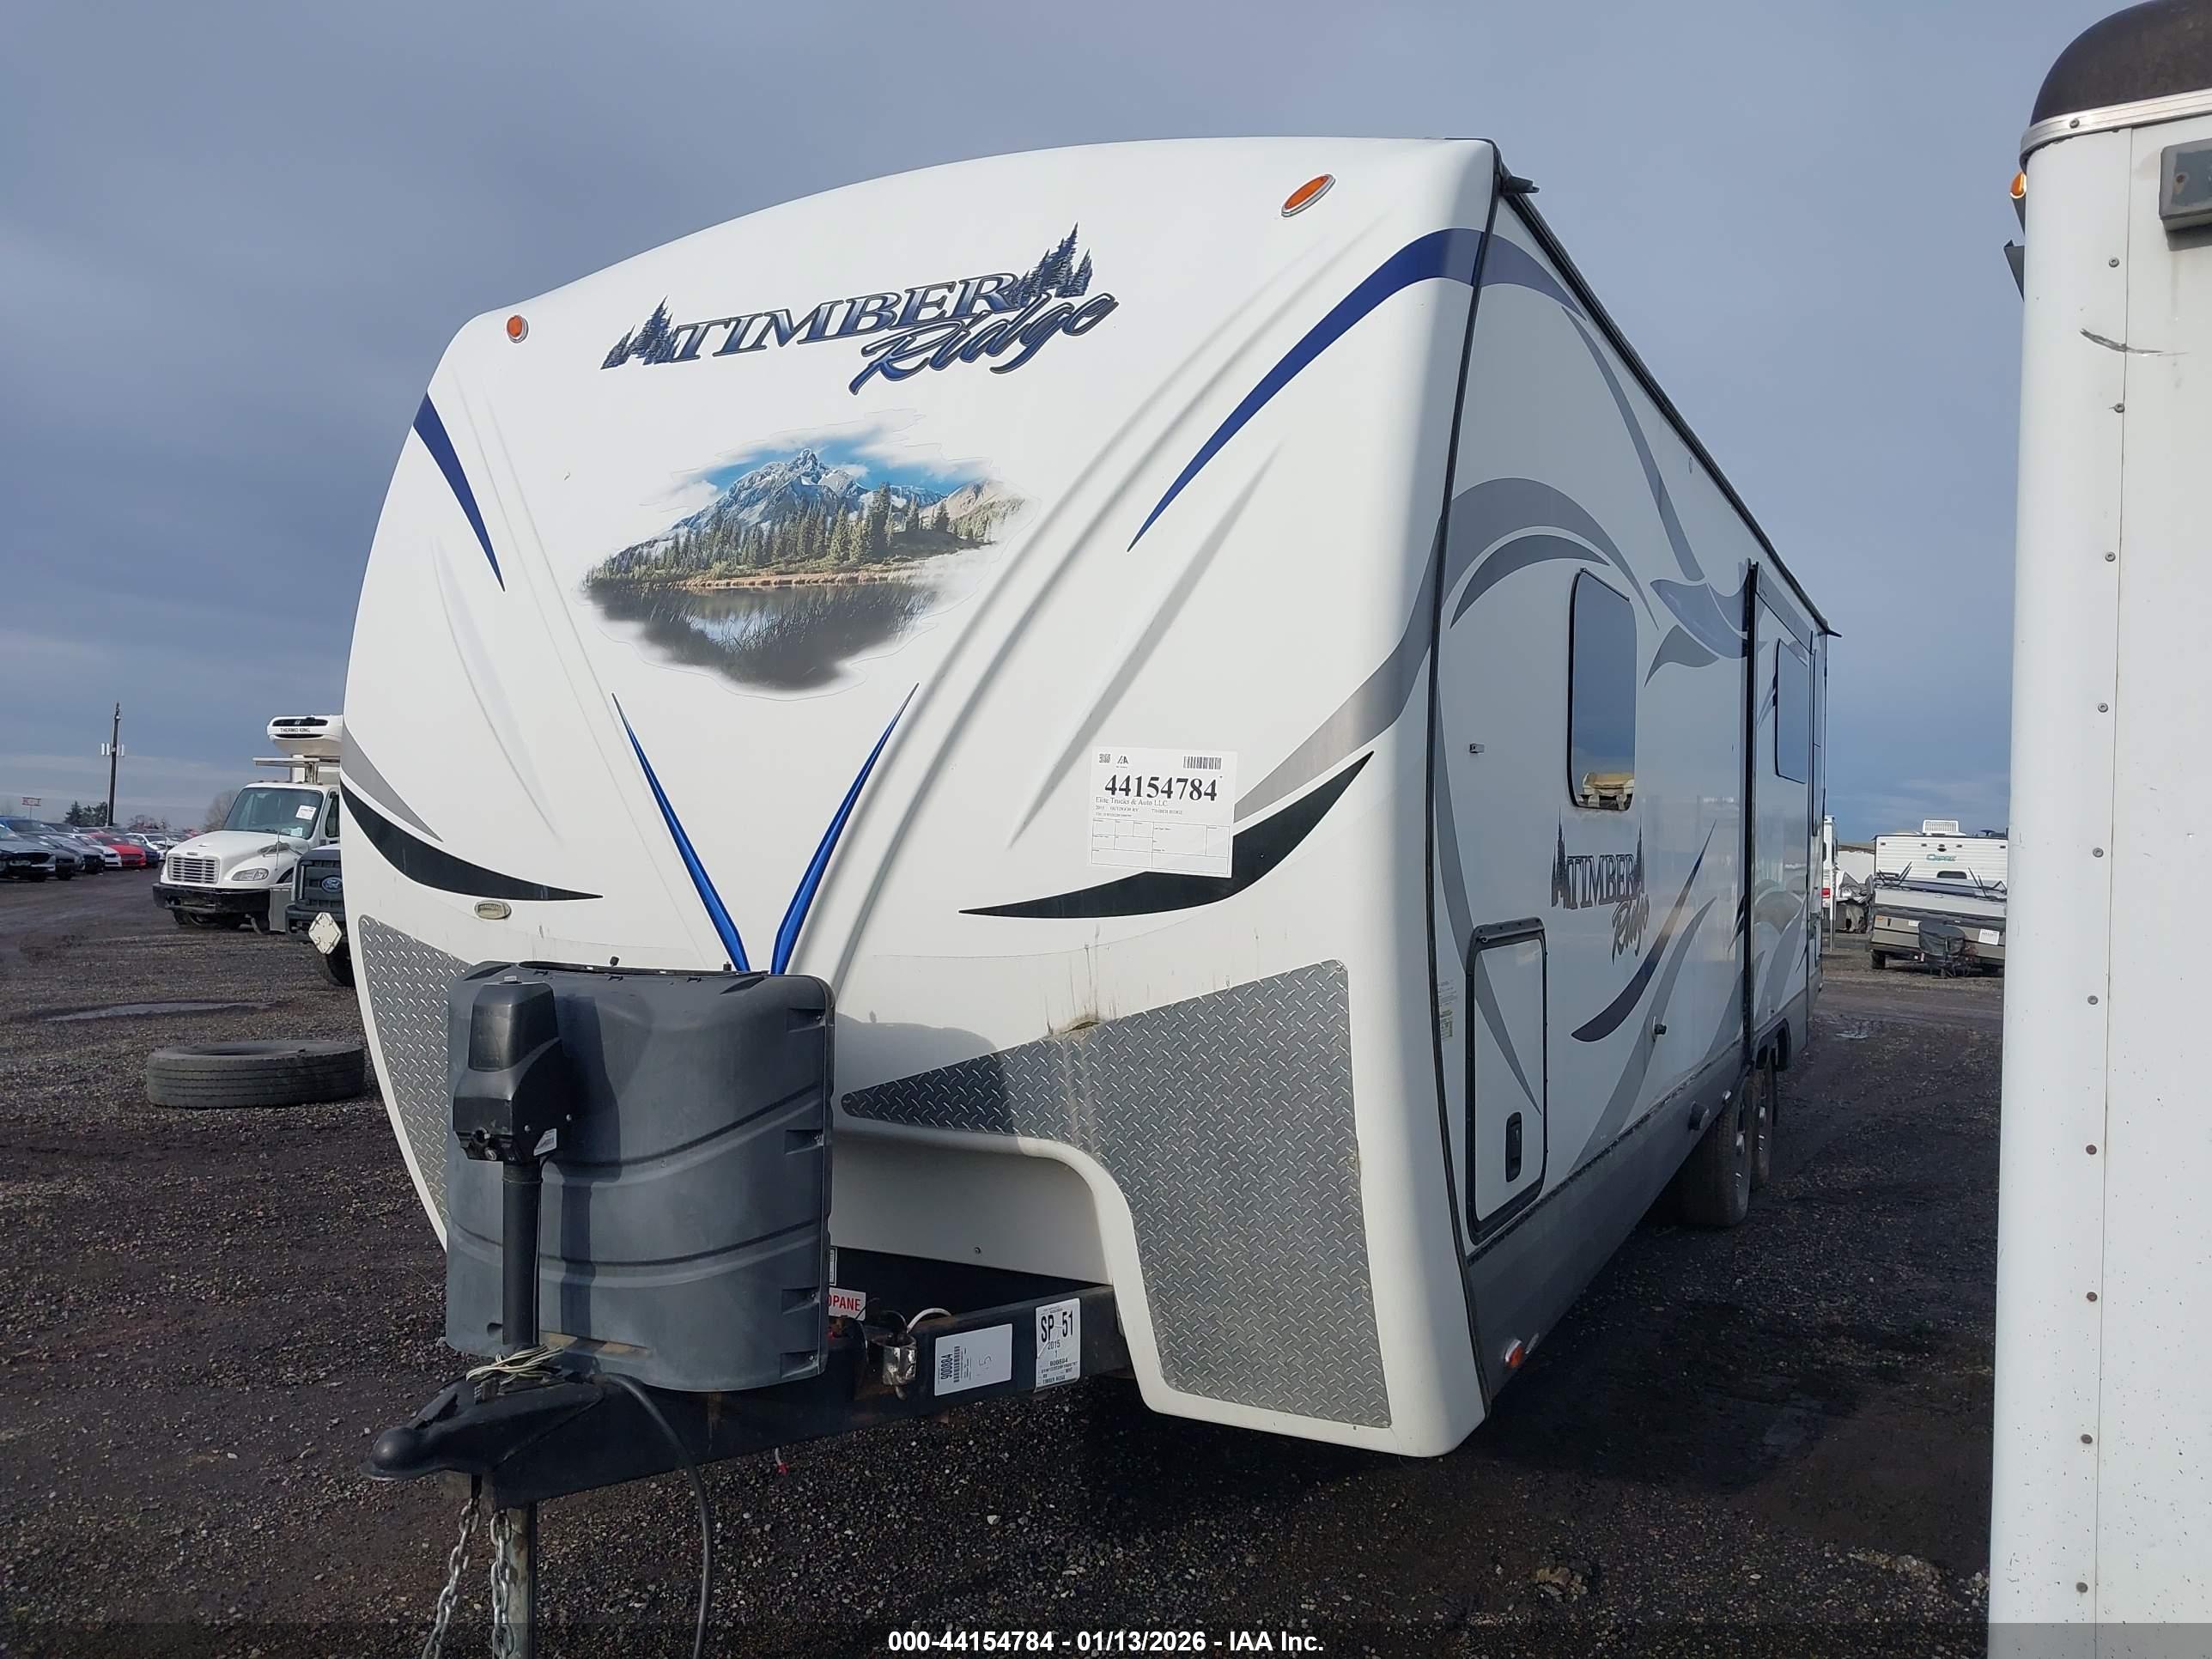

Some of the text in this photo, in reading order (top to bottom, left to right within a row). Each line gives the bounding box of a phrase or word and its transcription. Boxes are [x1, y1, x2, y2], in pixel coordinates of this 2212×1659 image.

[672, 272, 1020, 362] TIMBER
[848, 291, 1118, 395] Ridge
[1104, 774, 1218, 801] 44154784
[1565, 854, 1637, 909] TIMBER
[1041, 1310, 1073, 1343] SP 51
[1048, 1340, 1060, 1350] 2015
[940, 1353, 953, 1380] 900884
